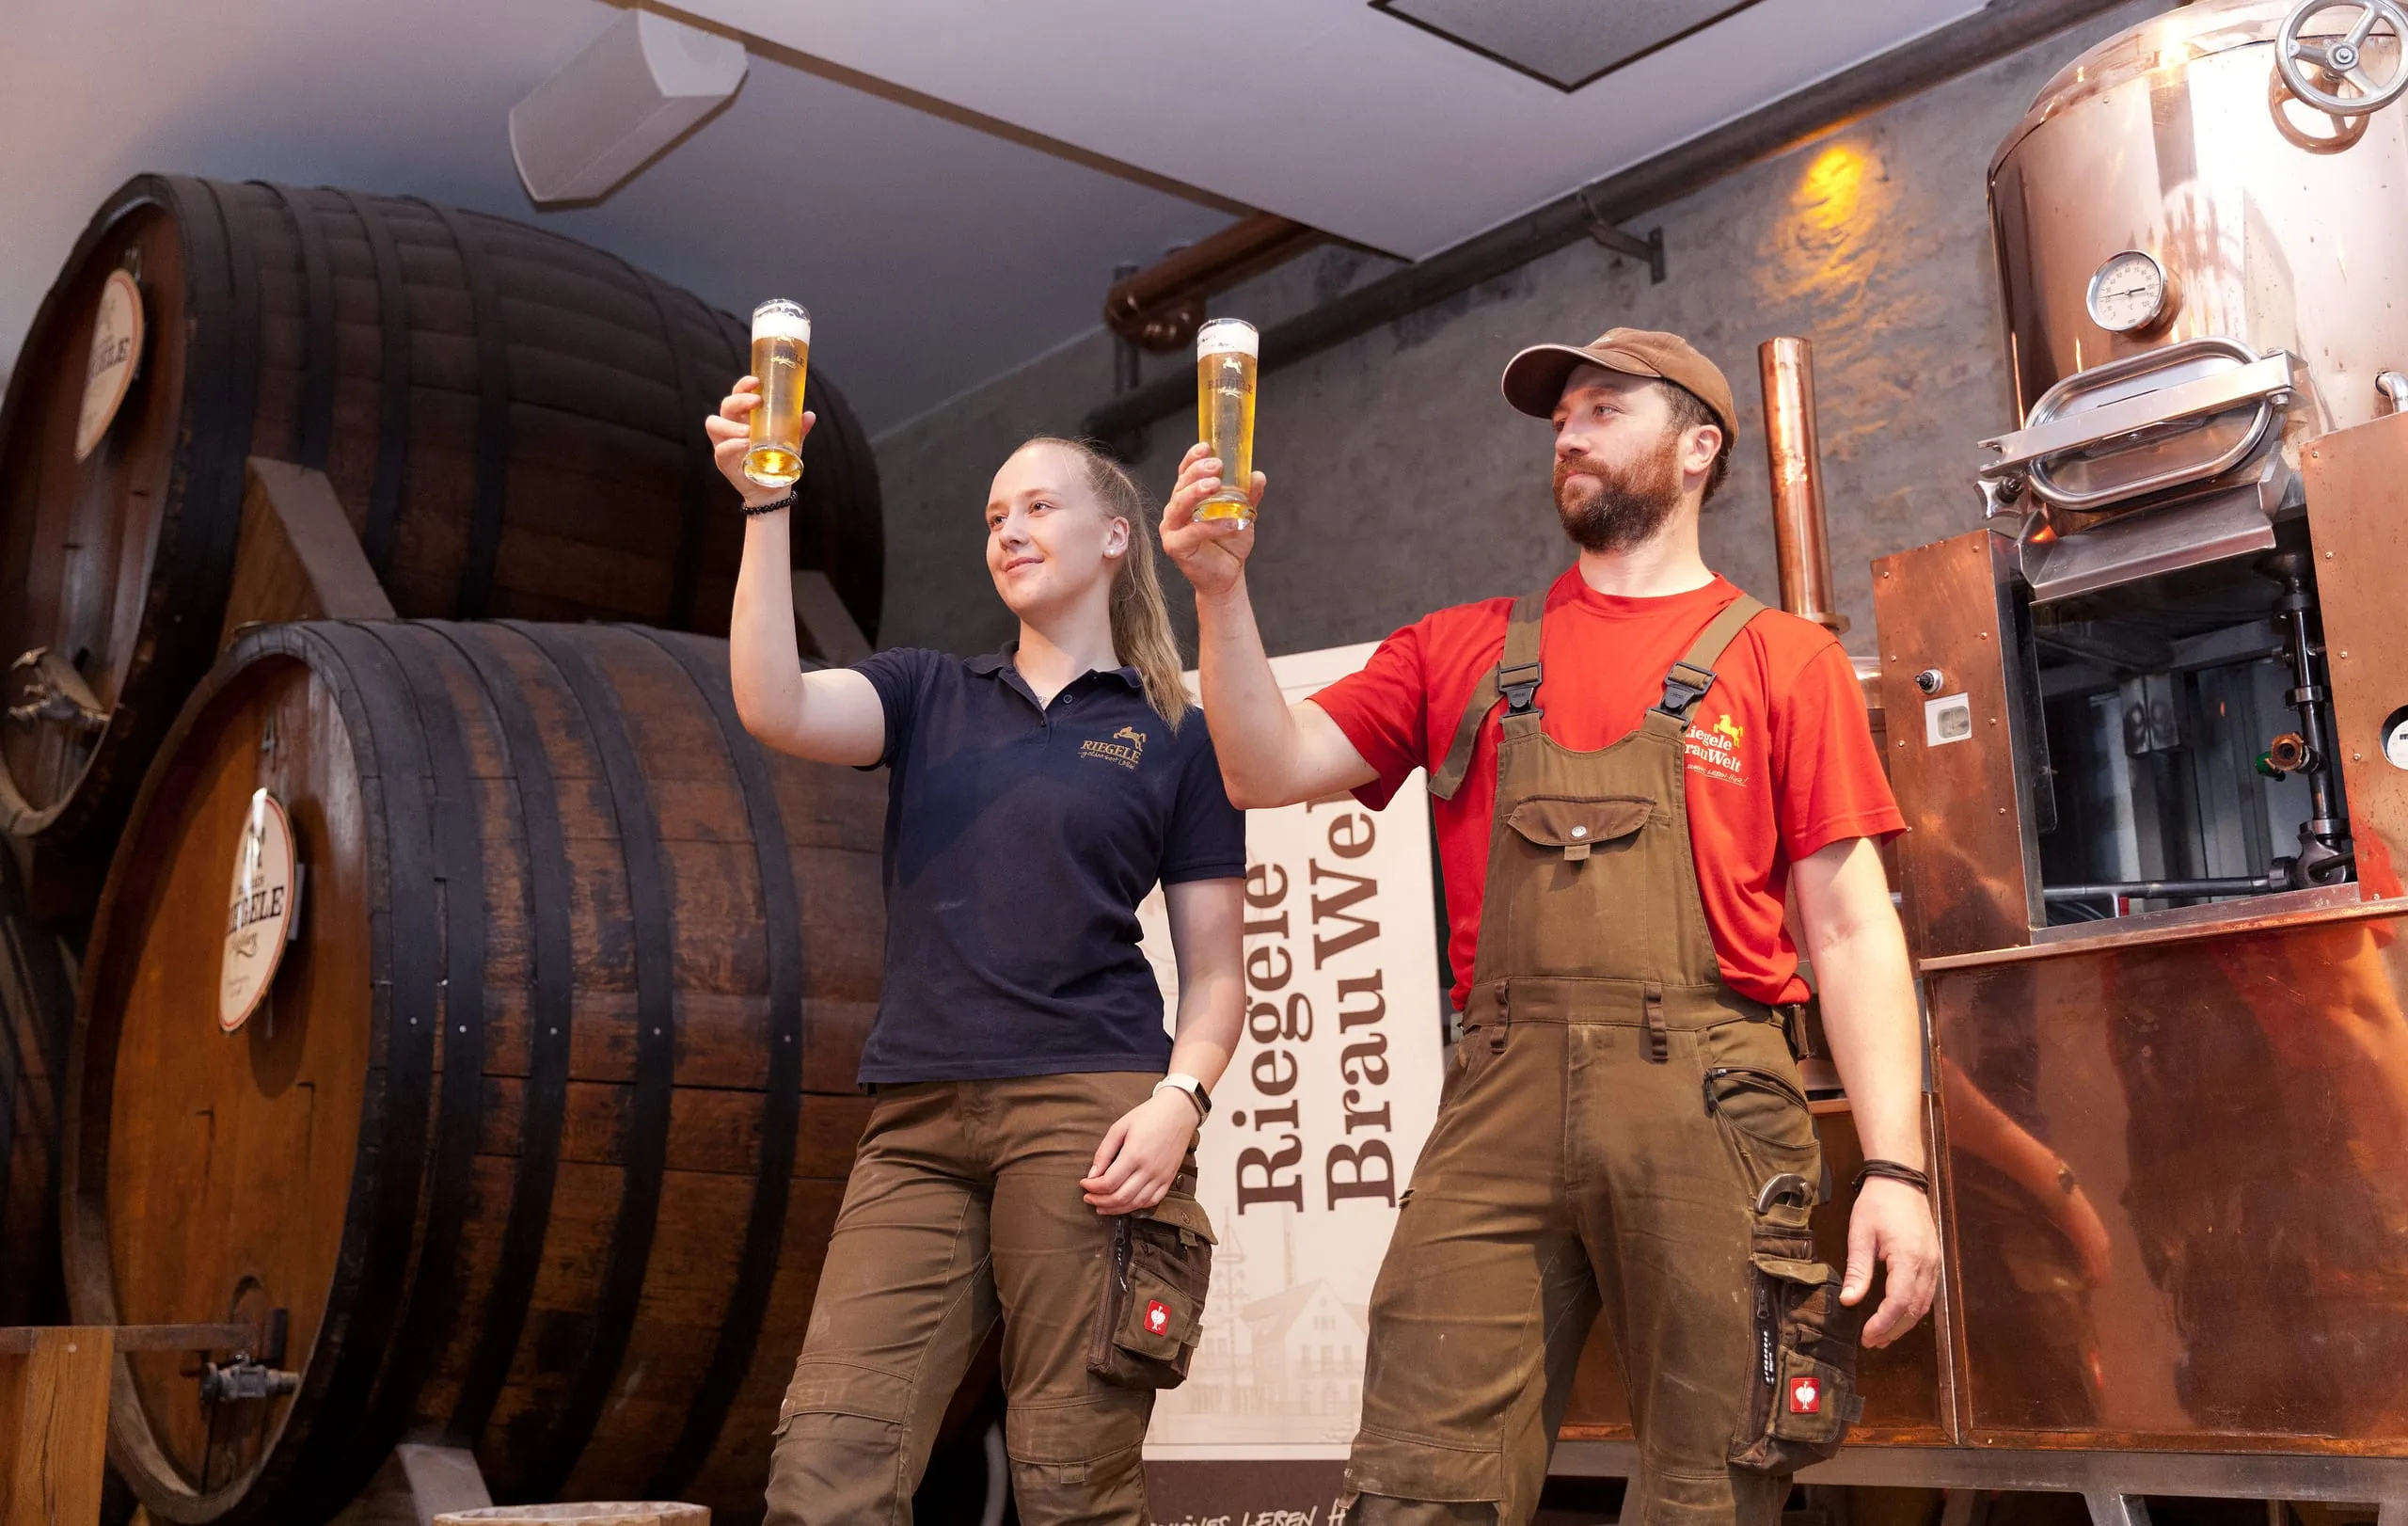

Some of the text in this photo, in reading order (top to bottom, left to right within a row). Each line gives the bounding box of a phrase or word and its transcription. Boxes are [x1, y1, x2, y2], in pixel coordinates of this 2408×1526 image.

[1080, 740, 1141, 765] RIEGELE
[1685, 725, 1733, 751] iegele
[1684, 741, 1742, 773] rauWelt
[1306, 787, 1397, 1212] BrauWe
[1231, 862, 1314, 1216] Riegele
